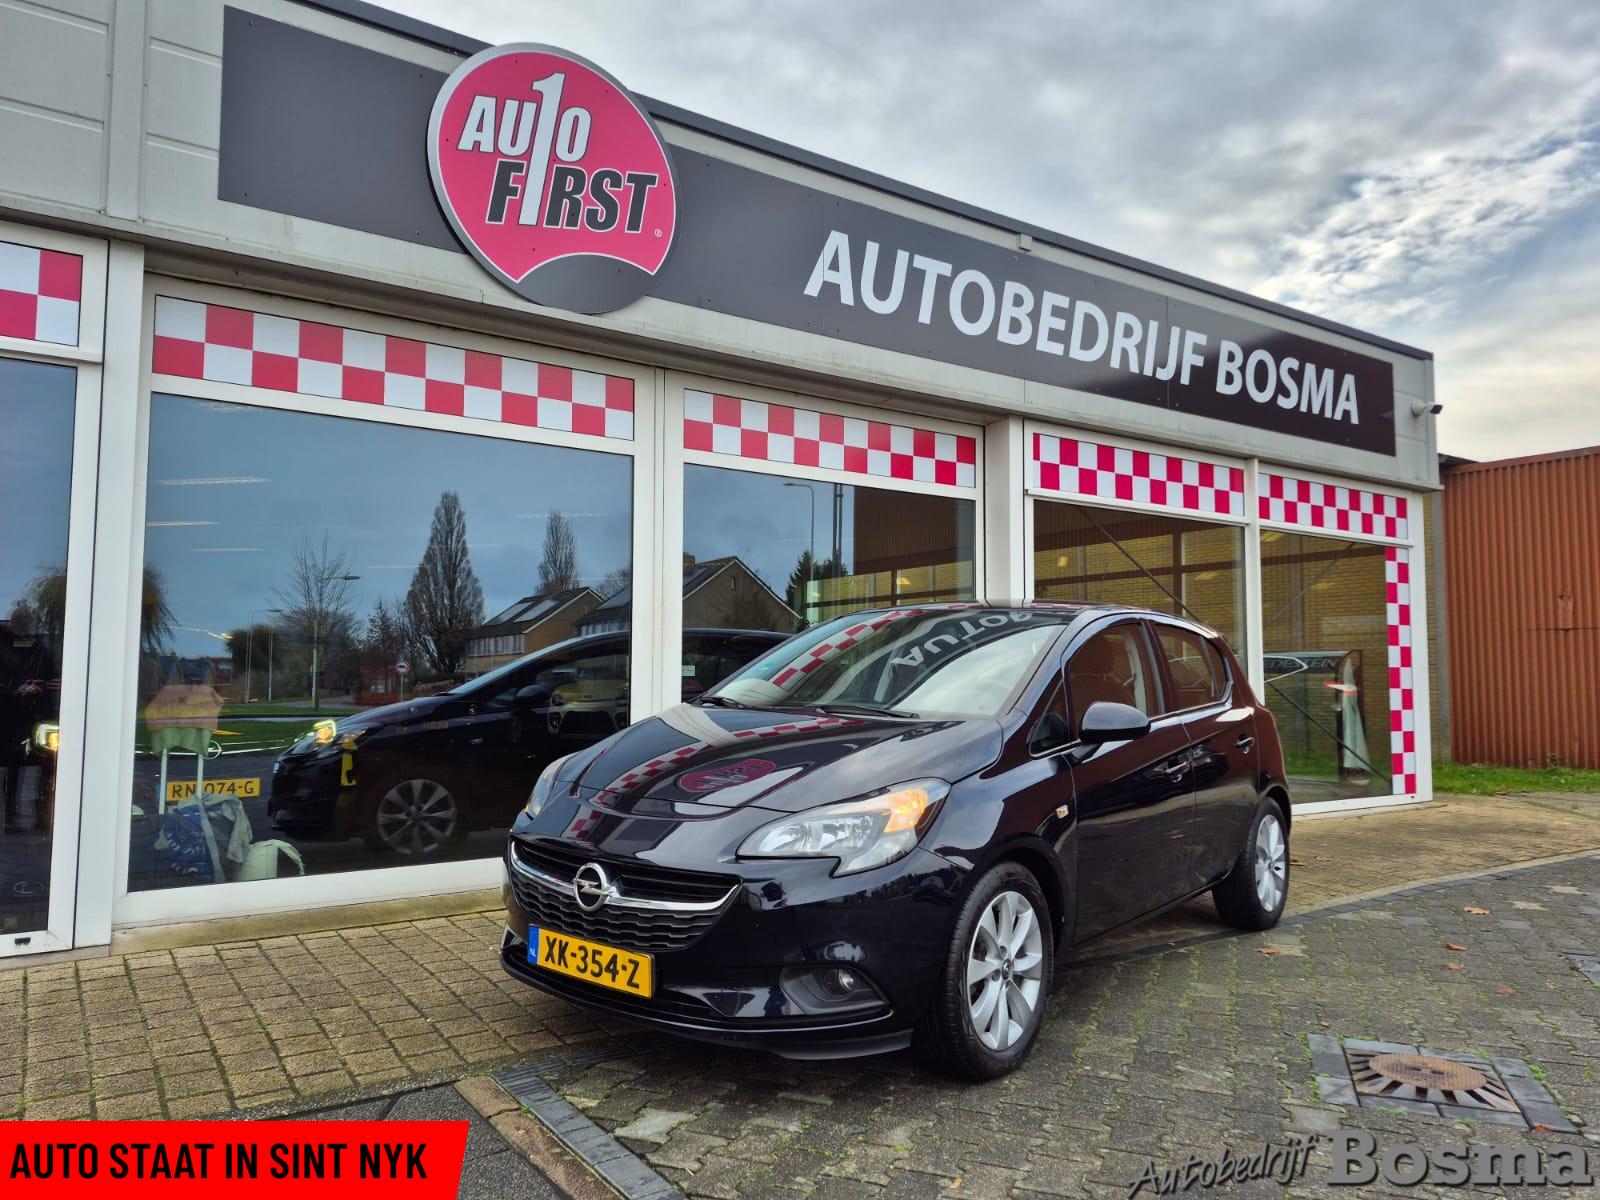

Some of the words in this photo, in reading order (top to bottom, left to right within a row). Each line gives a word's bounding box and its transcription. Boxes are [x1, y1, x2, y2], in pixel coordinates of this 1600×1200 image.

[804, 230, 1208, 386] AUTOBEDRIJF
[1215, 340, 1360, 425] BOSMA
[545, 935, 640, 989] XK-354-Z
